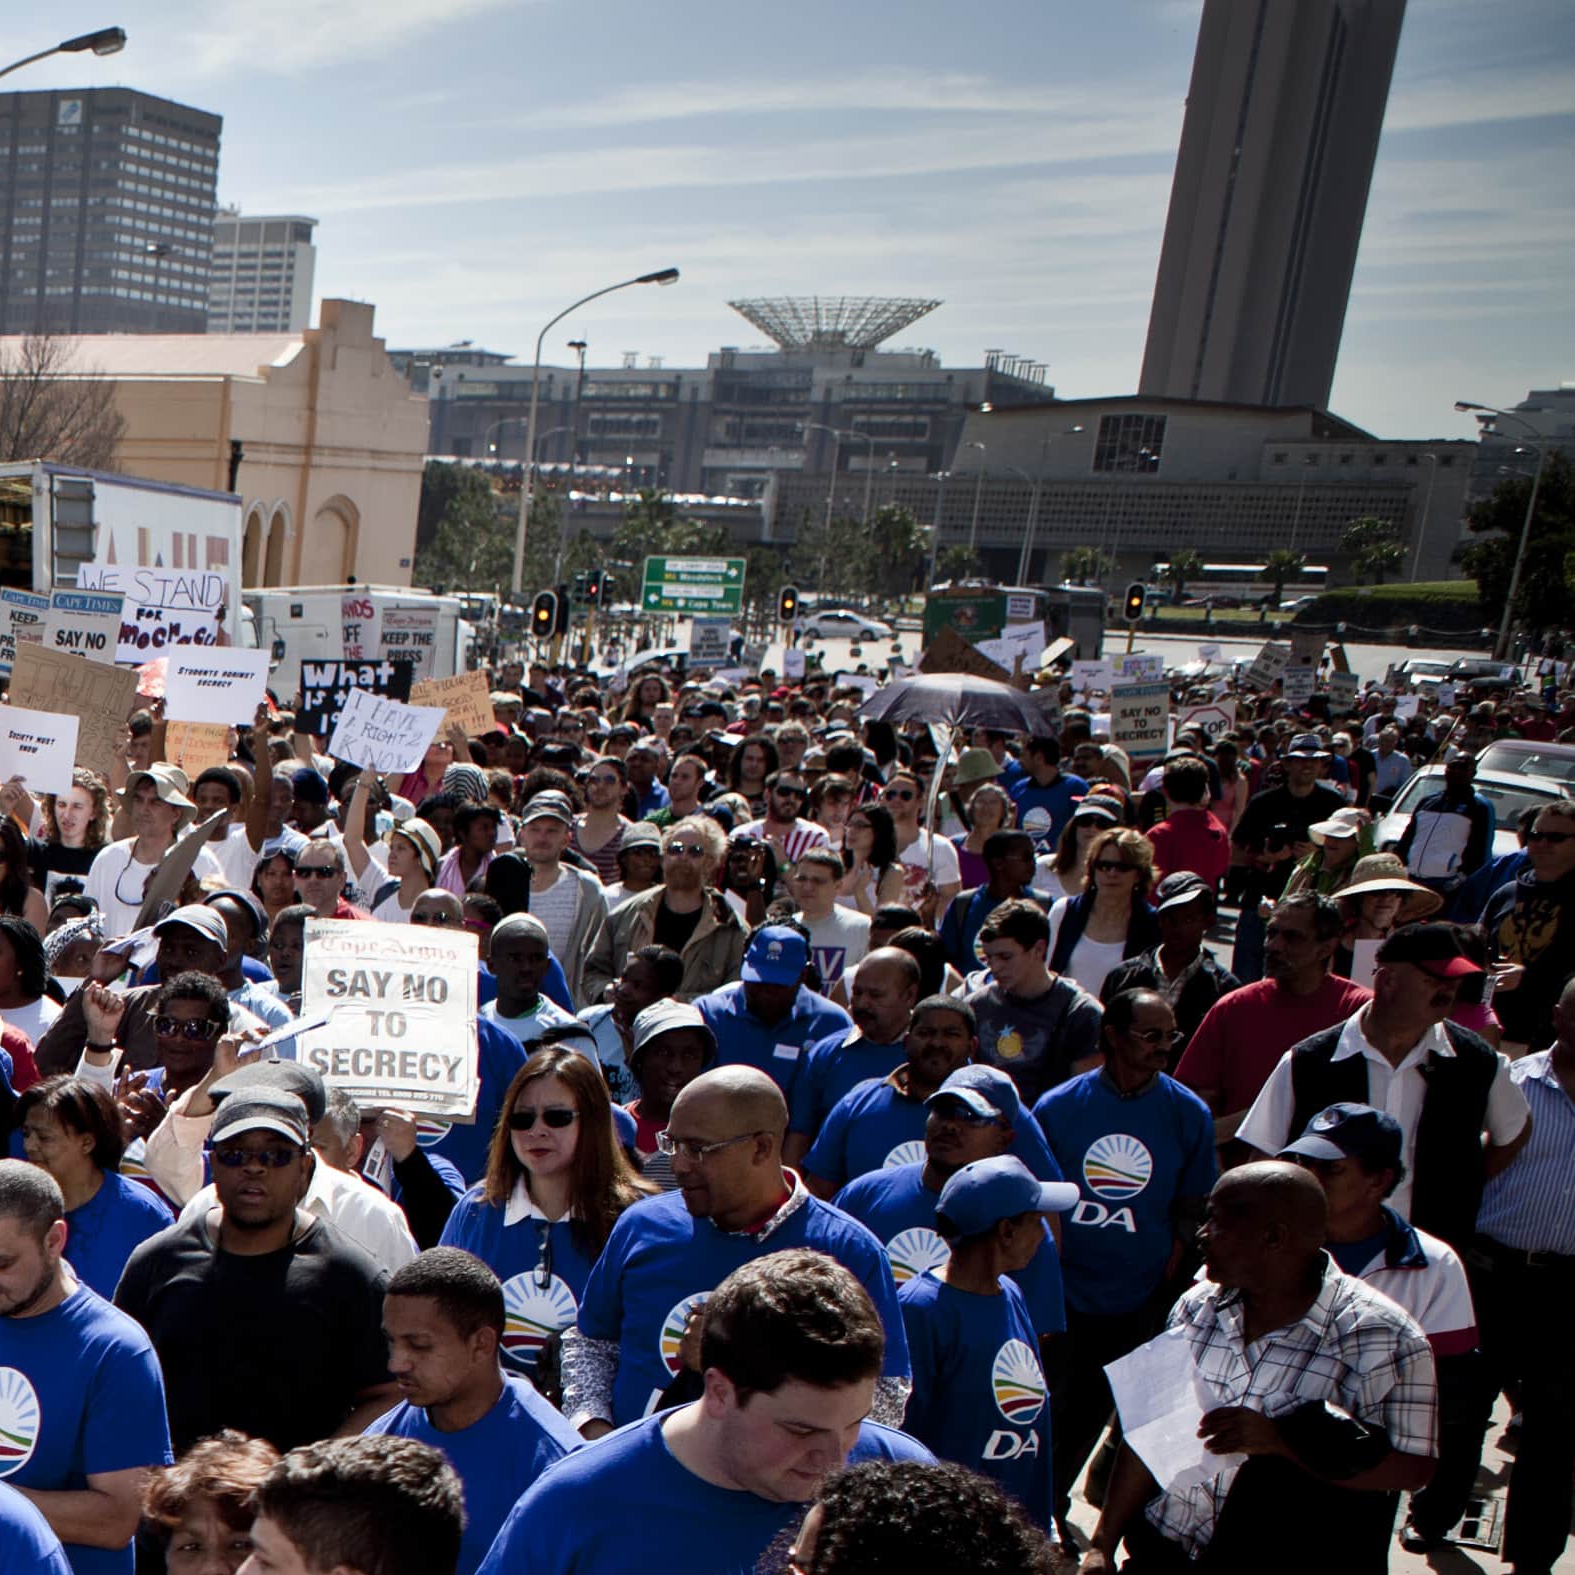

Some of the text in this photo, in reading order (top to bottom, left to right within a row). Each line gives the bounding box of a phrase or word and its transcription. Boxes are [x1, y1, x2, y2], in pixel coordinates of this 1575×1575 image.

[126, 571, 223, 607] STAND
[56, 596, 120, 612] CAPE TIMES
[55, 630, 106, 650] SAY NO
[381, 632, 433, 646] KEEP THE
[302, 661, 395, 688] What
[1120, 705, 1161, 718] SAY NO
[1134, 718, 1148, 728] TO
[1115, 727, 1165, 742] SECRECY
[326, 968, 448, 1004] SAY NO
[365, 1010, 407, 1038] TO
[308, 1047, 464, 1082] SECRECY
[1069, 1199, 1138, 1234] DA
[982, 1430, 1040, 1461] DA
